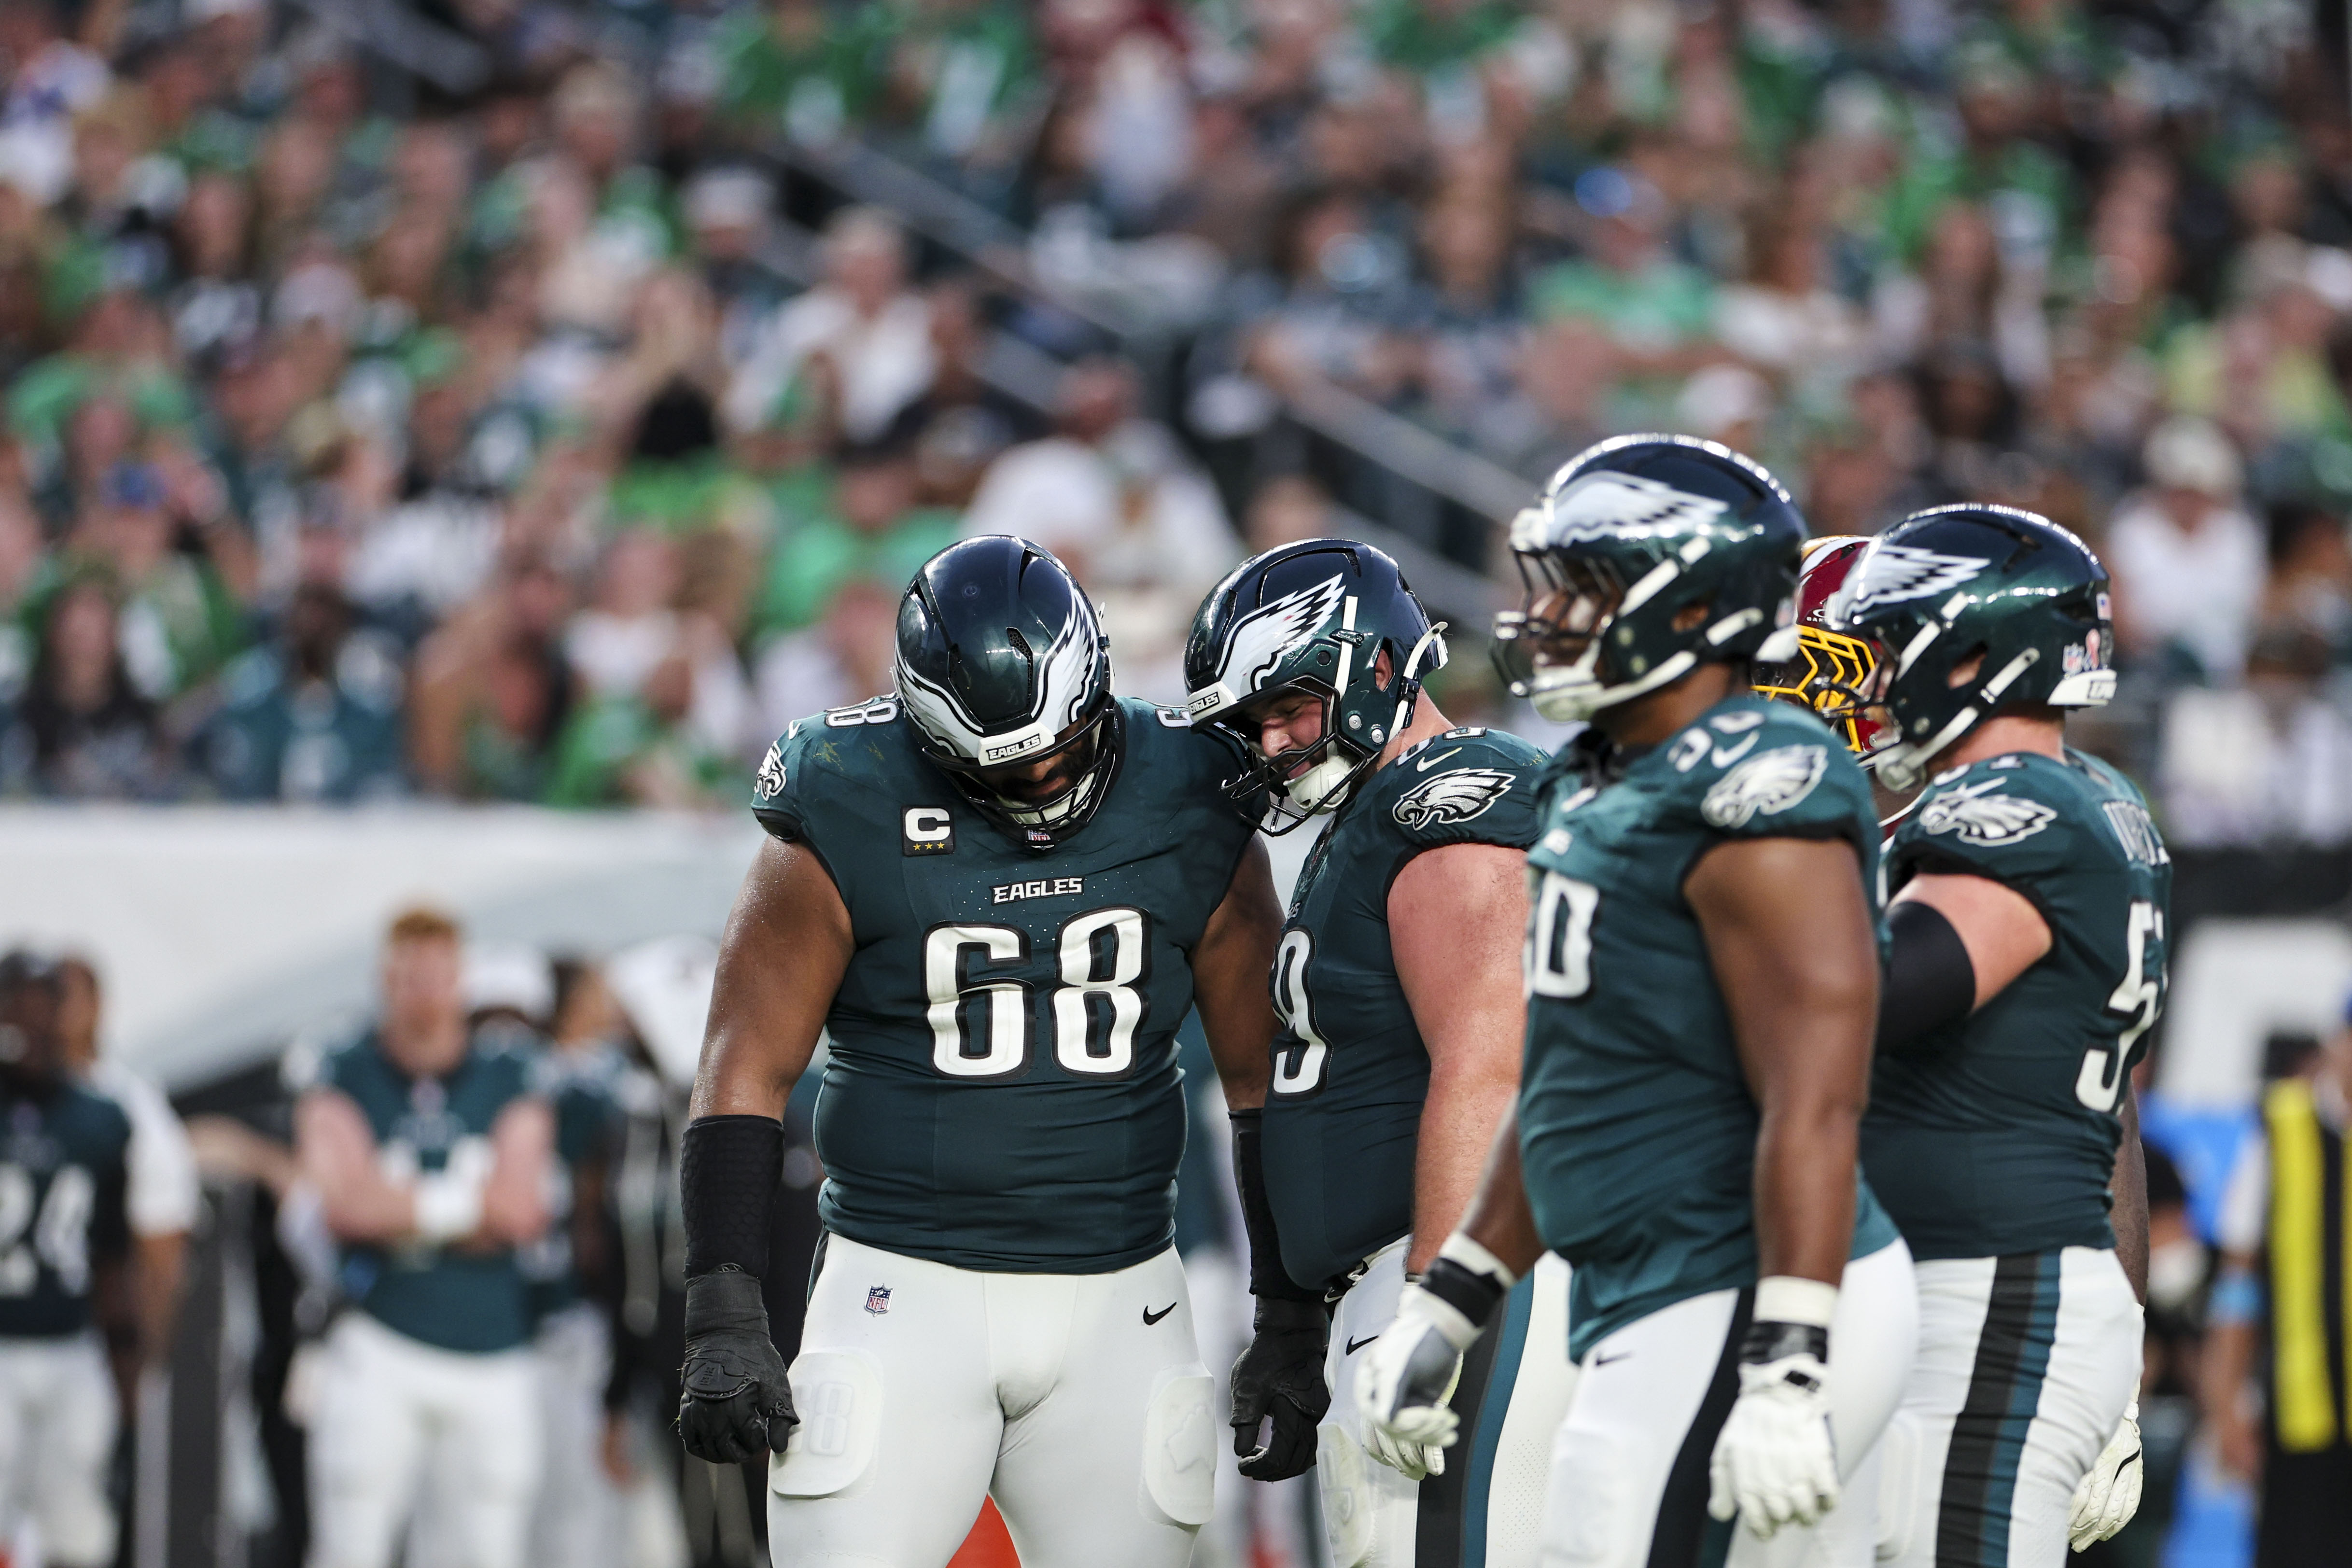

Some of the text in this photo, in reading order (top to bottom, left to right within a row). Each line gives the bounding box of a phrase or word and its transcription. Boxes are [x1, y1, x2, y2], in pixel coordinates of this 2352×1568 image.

[988, 735, 1040, 759] EAGLES
[905, 808, 950, 841] C
[993, 878, 1082, 904] EAGLES
[1523, 871, 1599, 999] 0
[924, 908, 1145, 1078] 68
[1272, 929, 1327, 1094] 9
[2075, 902, 2168, 1117] 5
[868, 1297, 885, 1310] NFL
